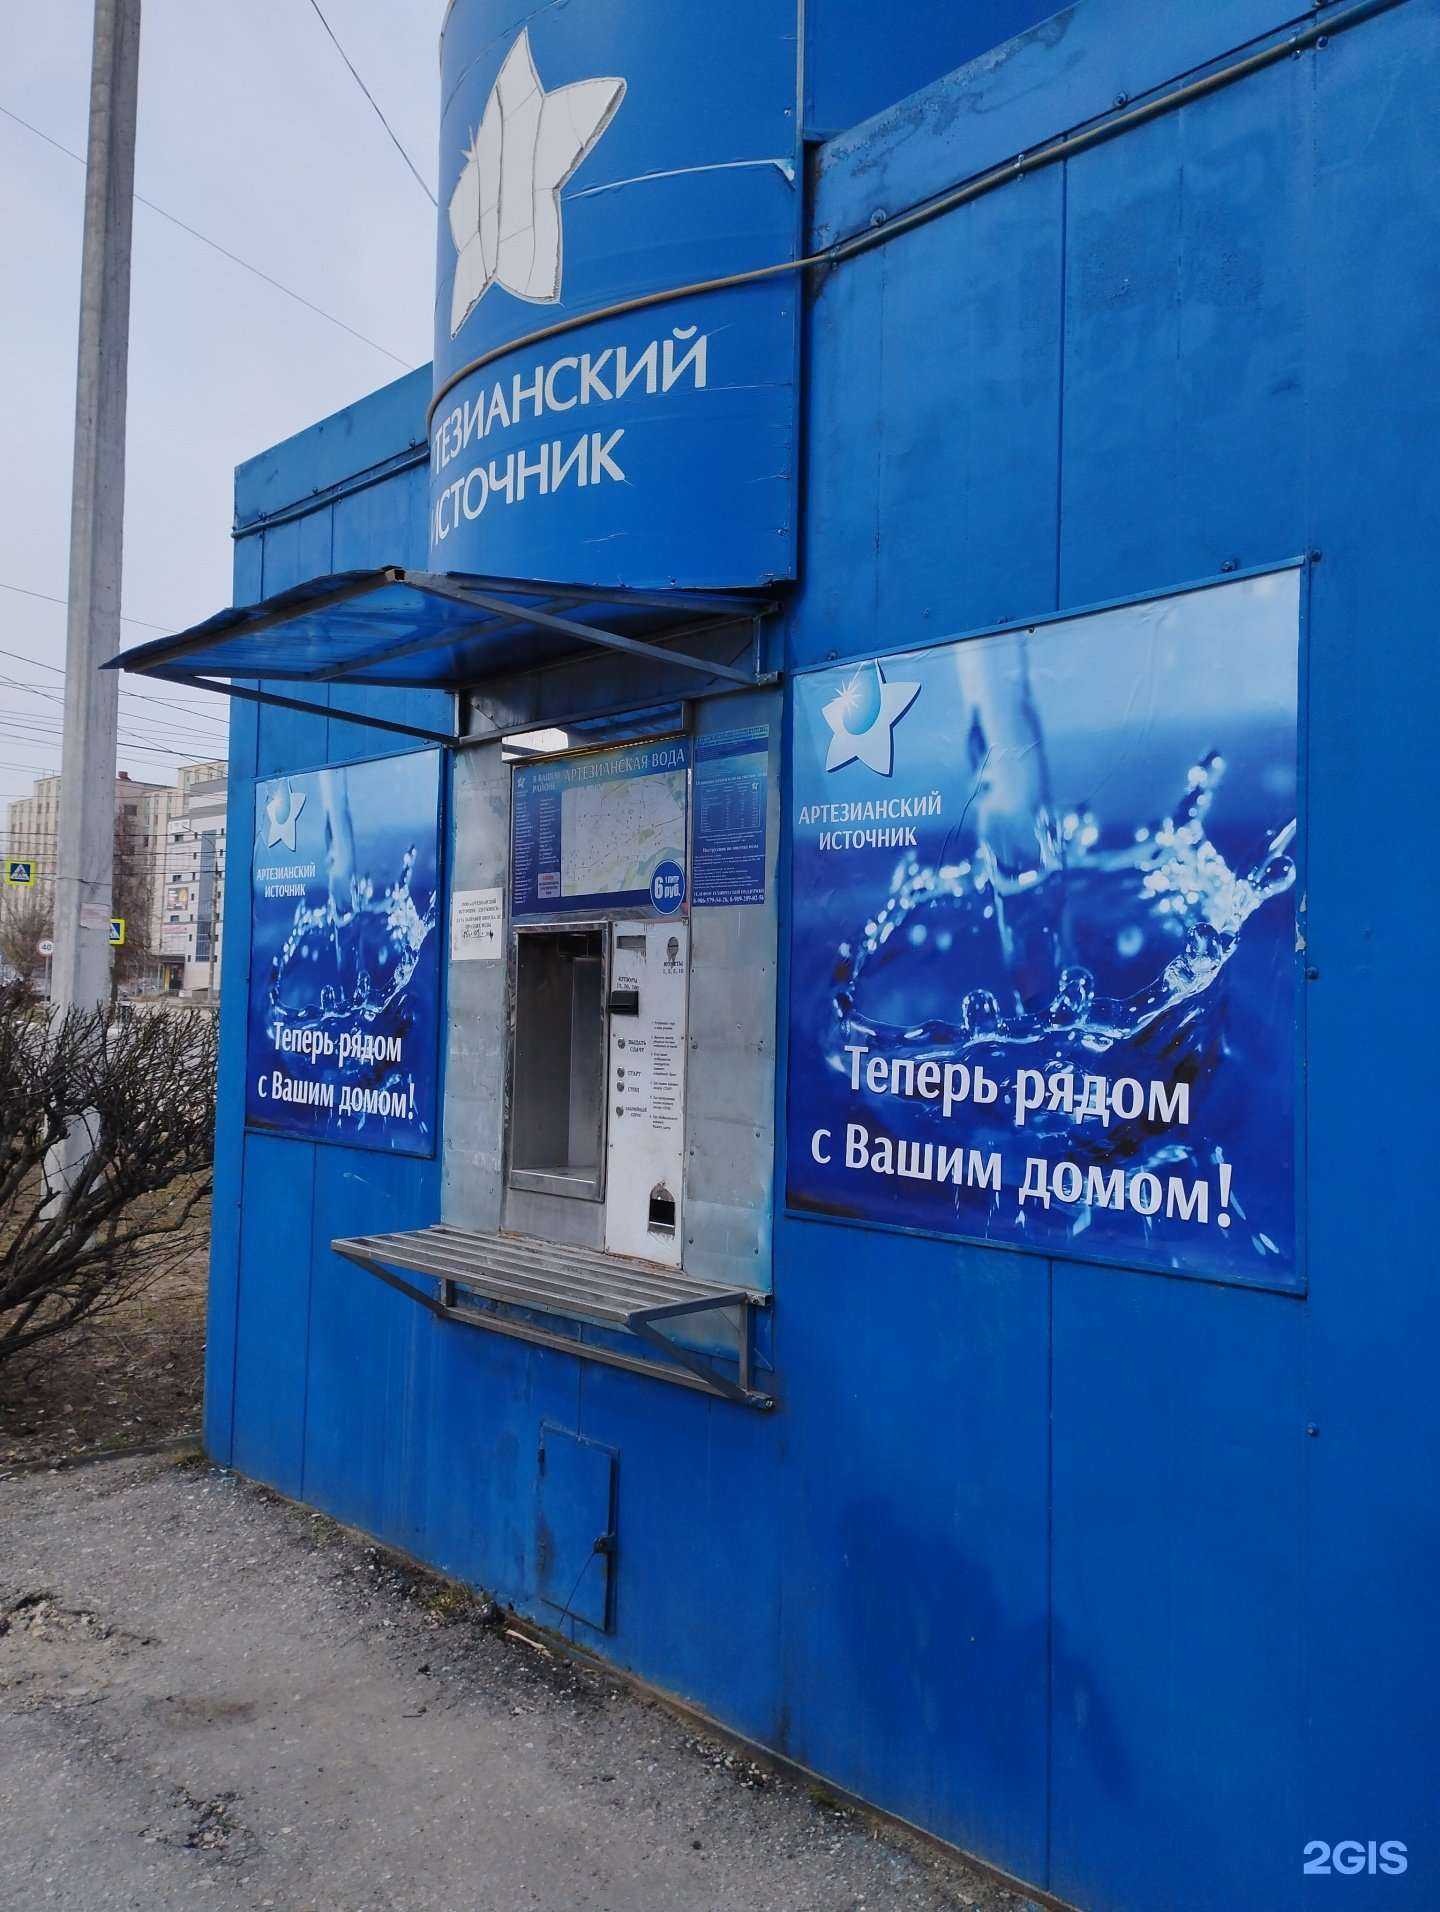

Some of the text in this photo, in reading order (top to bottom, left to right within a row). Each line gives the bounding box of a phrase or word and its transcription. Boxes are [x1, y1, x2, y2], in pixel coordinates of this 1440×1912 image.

[565, 748, 685, 784] АРТЕЗИАНСКАЯ ВОДА
[799, 790, 942, 825] АРТЕЗИАНСКИЙ
[819, 826, 918, 851] ИСТОЧНИК
[256, 861, 316, 881] АРТЕЗИАНСКИЙ
[654, 876, 664, 899] 6
[664, 884, 681, 899] руб.
[264, 883, 306, 898] ИСТОЧНИК
[273, 1022, 401, 1068] Теперь рядом
[258, 1071, 415, 1120] с Вашим домом!
[844, 1045, 1190, 1127] Теперь рядом
[811, 1123, 1232, 1228] с Вашим домом!
